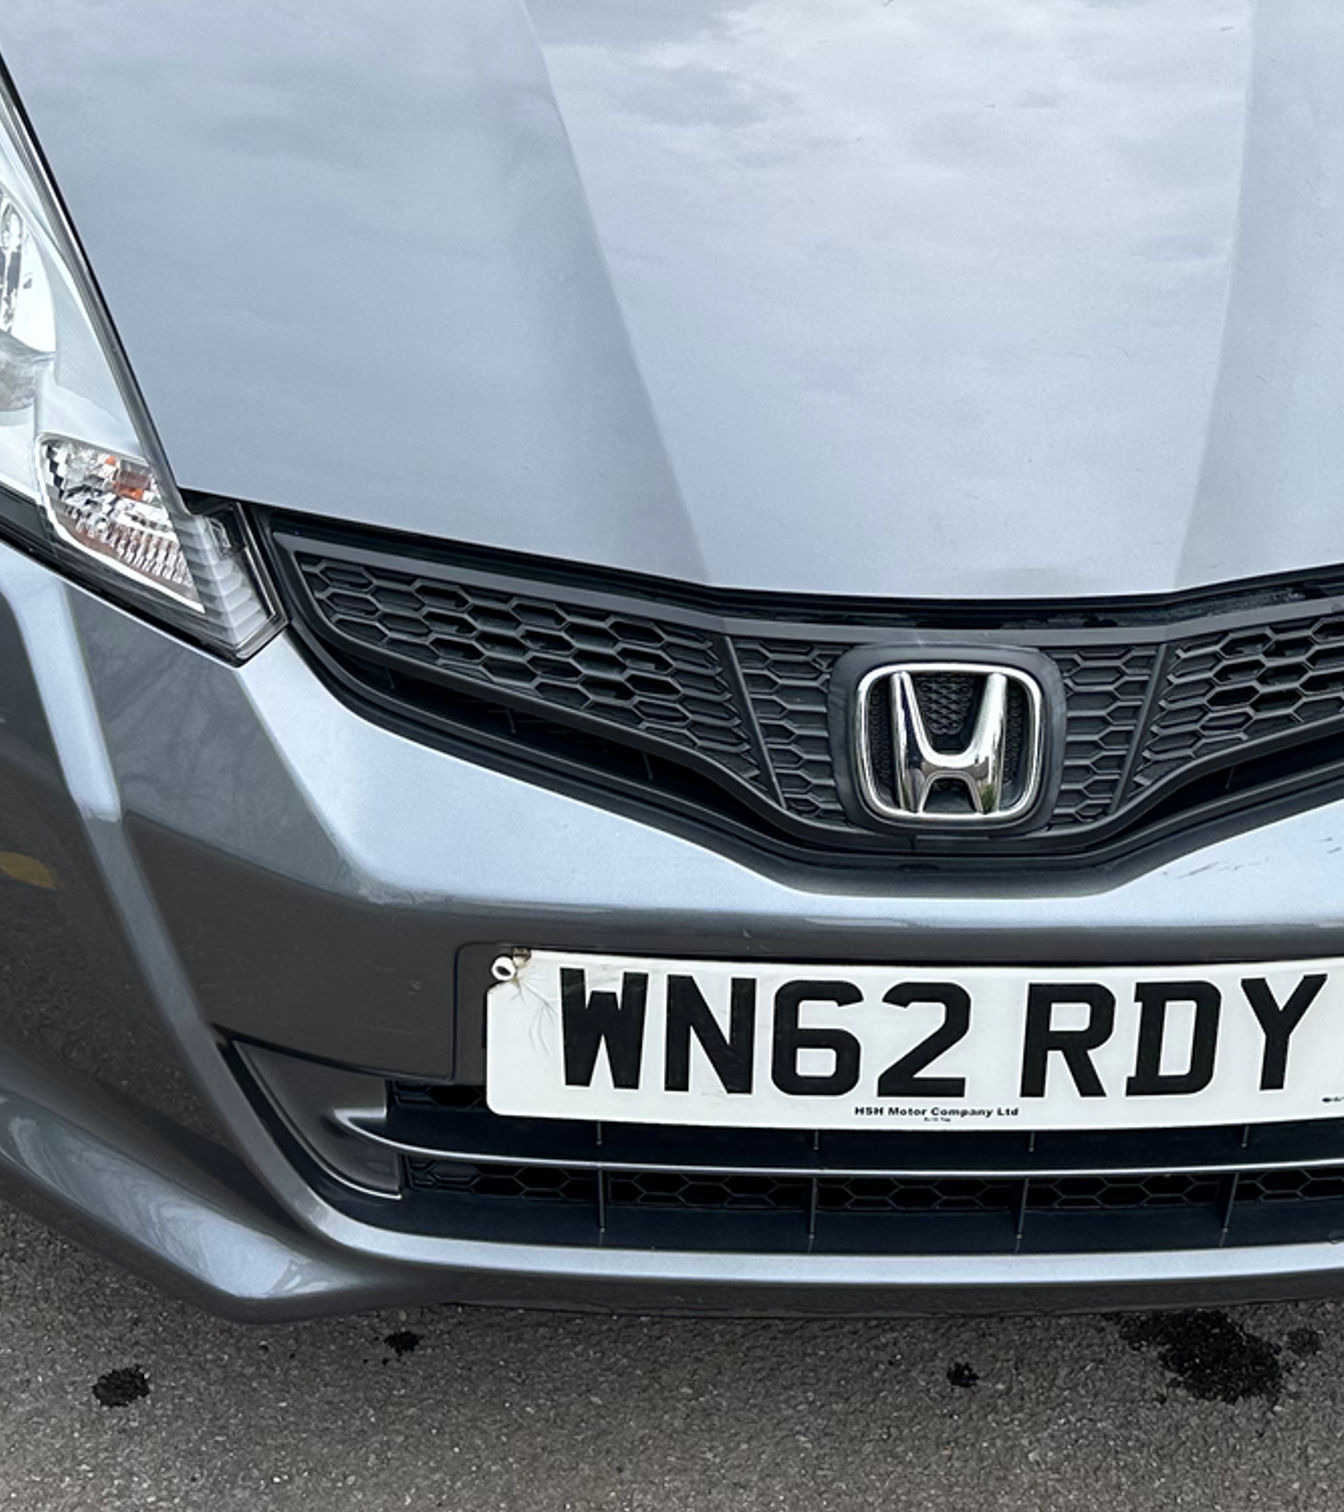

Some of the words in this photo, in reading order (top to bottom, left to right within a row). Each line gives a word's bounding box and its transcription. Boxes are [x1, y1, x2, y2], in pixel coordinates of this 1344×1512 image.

[560, 968, 972, 1097] WN62
[1020, 974, 1328, 1098] RDY
[854, 1106, 884, 1116] HSH
[888, 1106, 927, 1116] Motor
[931, 1106, 993, 1118] Company
[997, 1106, 1019, 1116] Ltd
